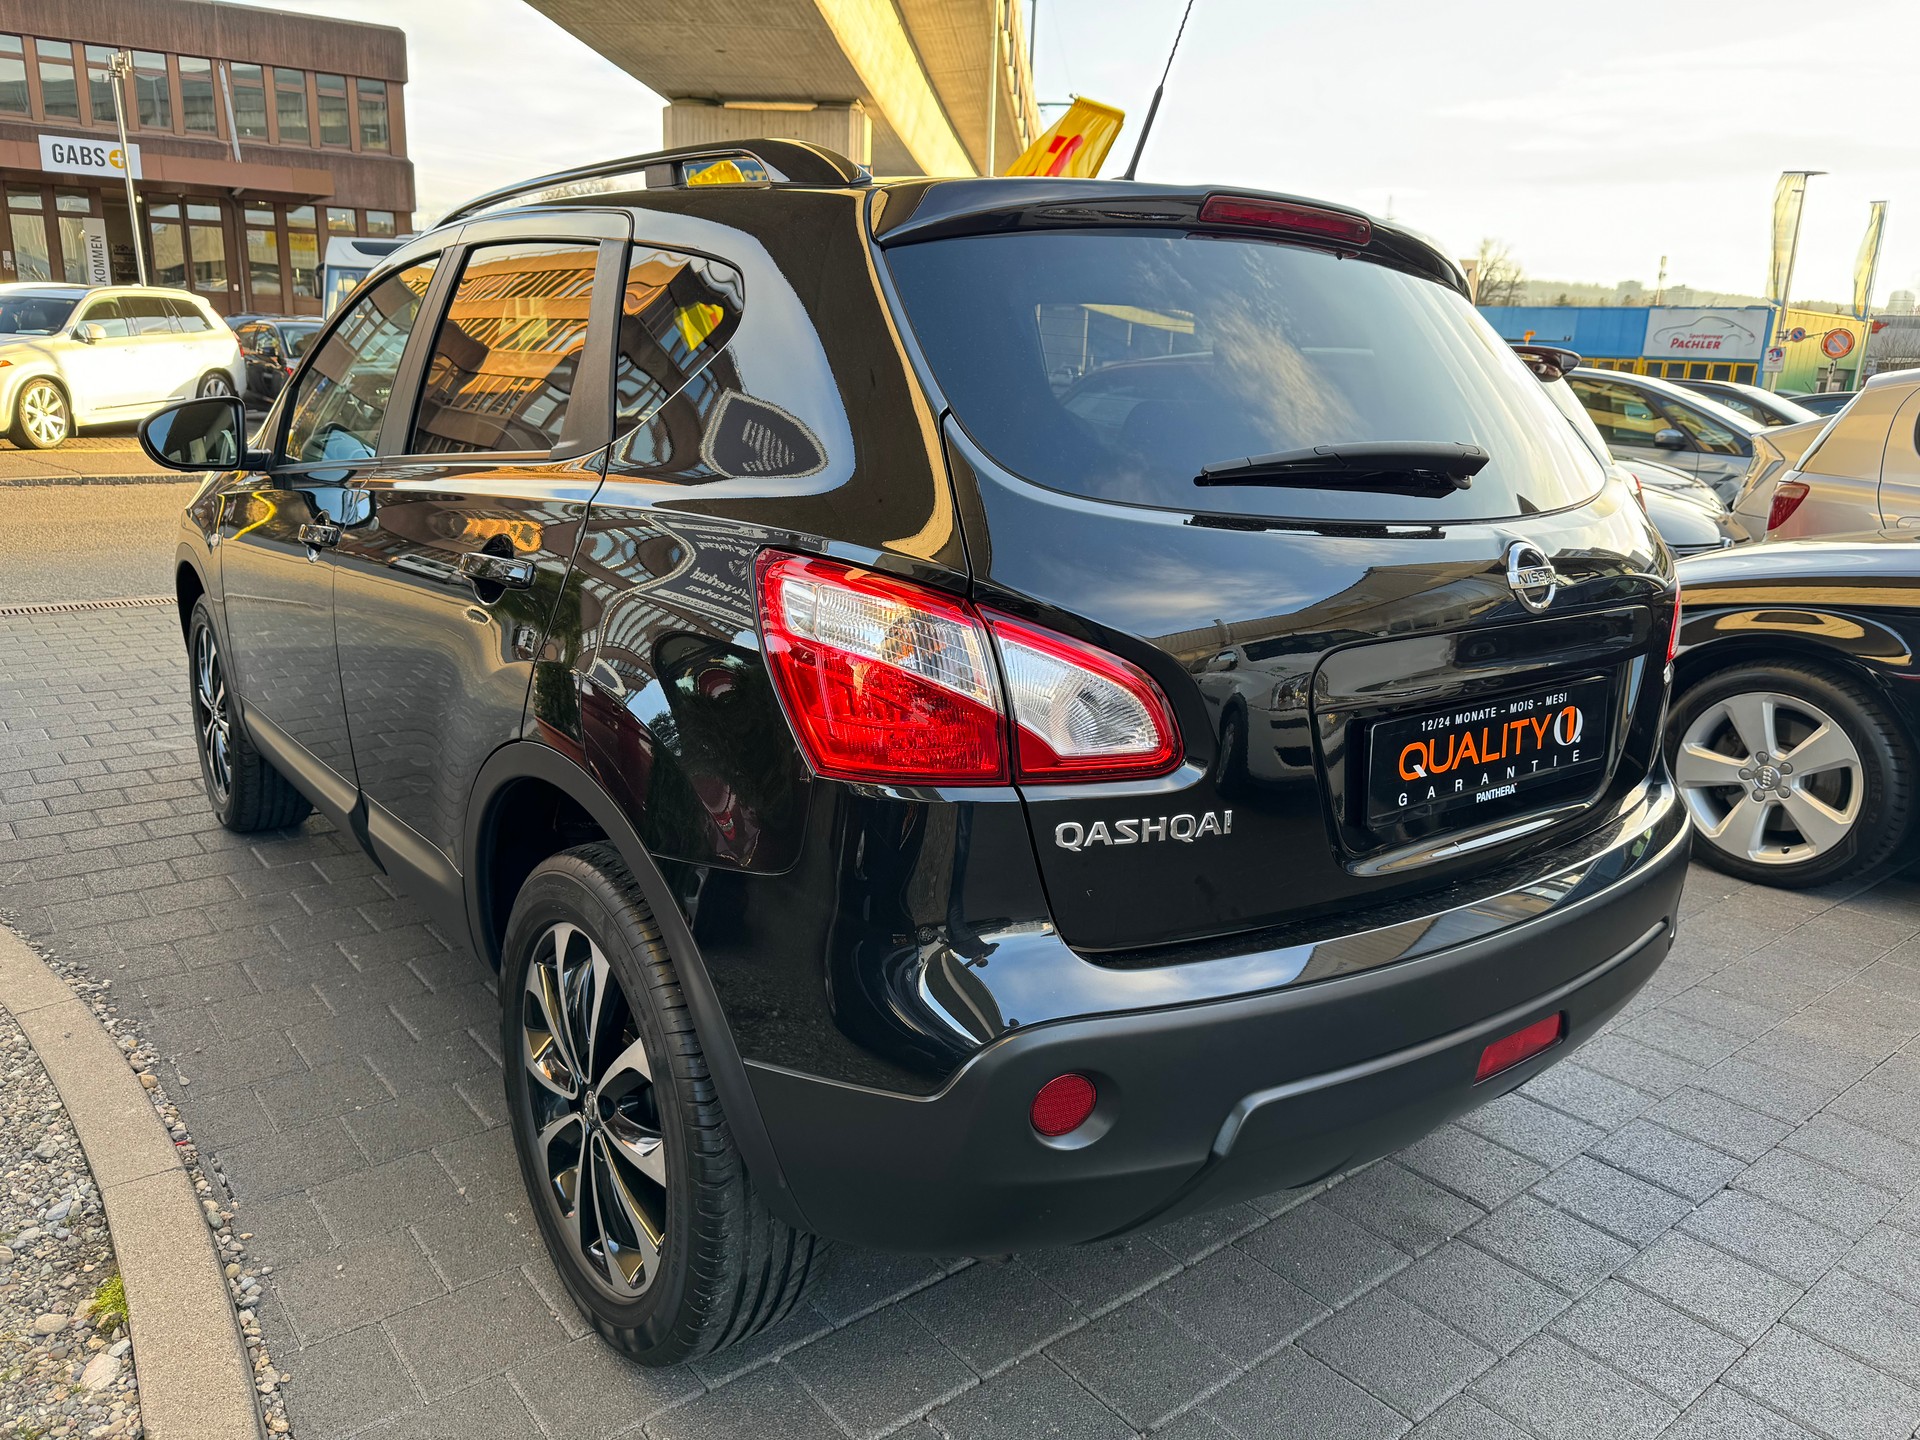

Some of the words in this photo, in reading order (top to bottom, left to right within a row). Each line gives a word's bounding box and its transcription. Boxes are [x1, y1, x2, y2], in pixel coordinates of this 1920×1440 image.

[51, 143, 106, 167] GABS
[90, 234, 107, 286] KOMMEN
[1670, 338, 1721, 350] PACHLER
[1421, 715, 1451, 732] 12/24
[1455, 707, 1497, 725] MONATE
[1509, 699, 1534, 714] MOIS
[1545, 692, 1568, 707] MESI
[1398, 713, 1553, 781] QUALITY
[1398, 749, 1580, 807] GARANTIE
[1476, 783, 1517, 804] PANTHERA
[1055, 810, 1233, 852] QASHQAI
